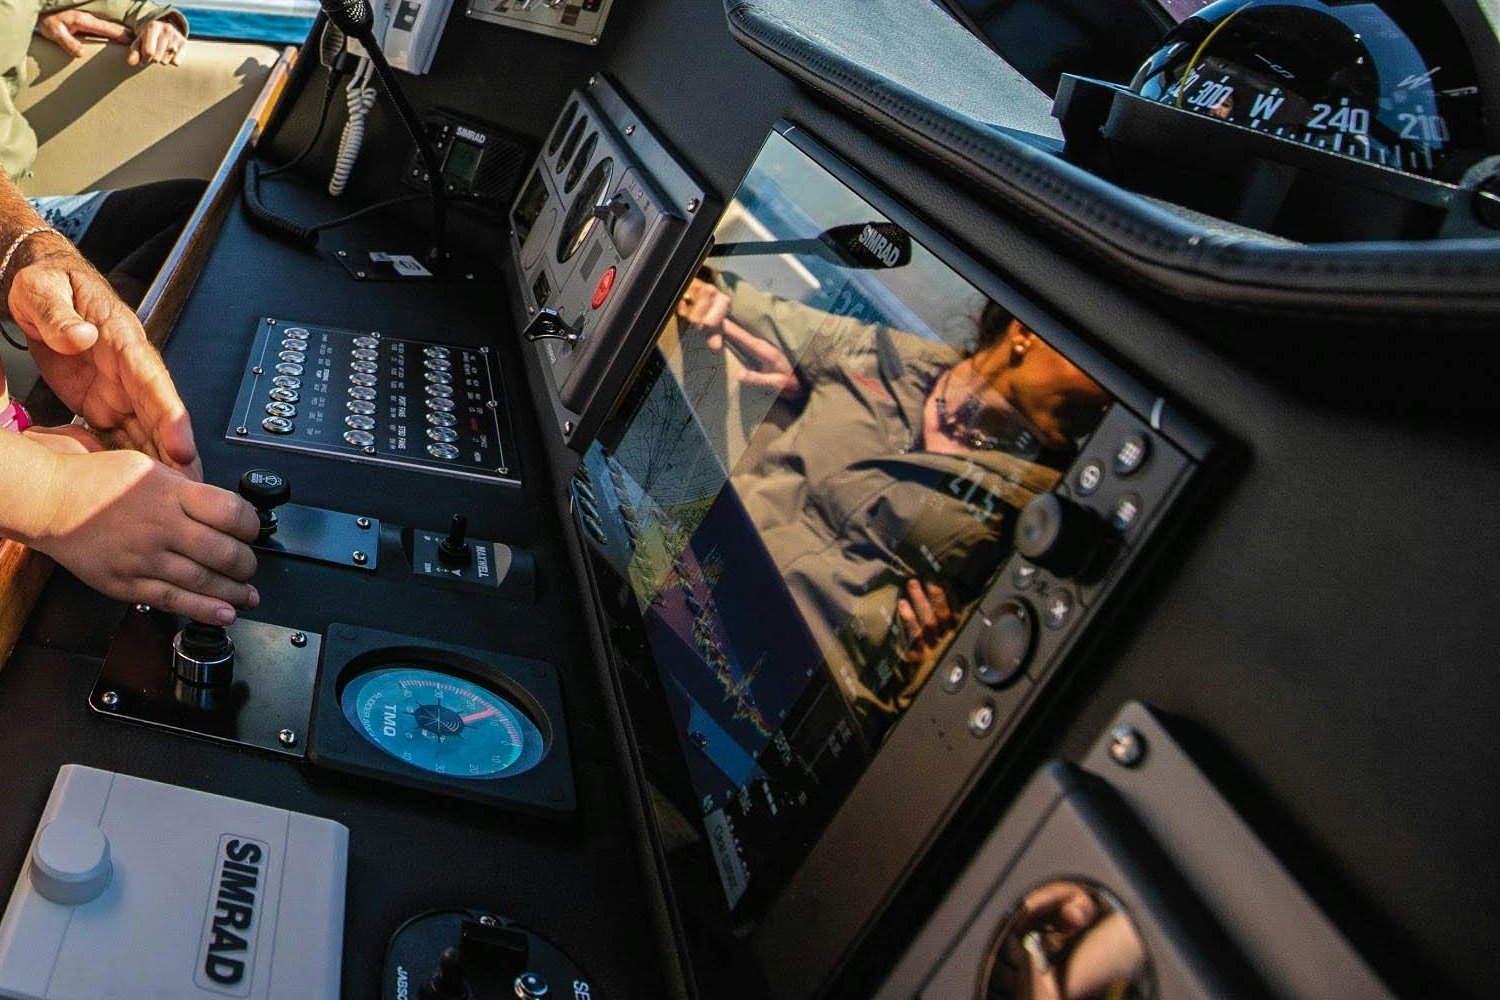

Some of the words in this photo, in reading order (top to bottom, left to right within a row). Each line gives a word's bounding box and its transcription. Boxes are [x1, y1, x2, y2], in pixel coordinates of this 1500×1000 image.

[1187, 80, 1234, 110] 300
[1249, 93, 1285, 121] W
[1306, 102, 1370, 136] 240
[456, 125, 486, 144] SIMRAD
[859, 224, 900, 267] SIMRAD
[476, 545, 489, 577] MAXWELL
[384, 704, 397, 738] TMQ
[205, 839, 262, 985] SIMRAD
